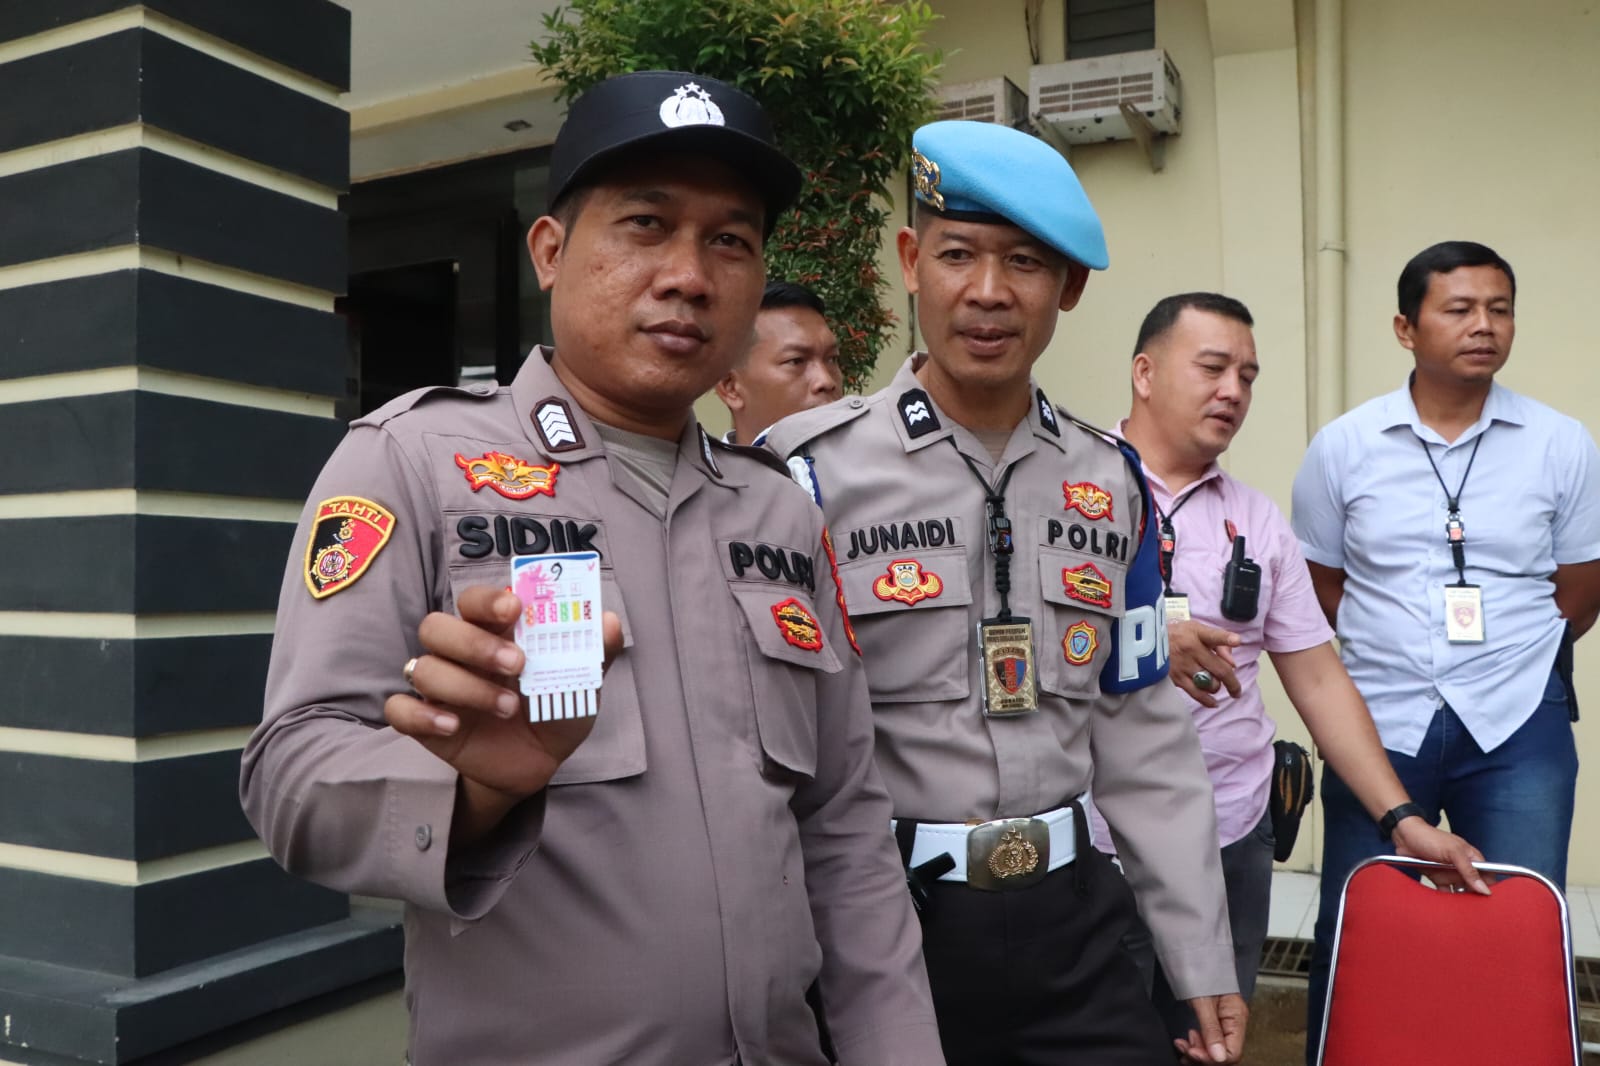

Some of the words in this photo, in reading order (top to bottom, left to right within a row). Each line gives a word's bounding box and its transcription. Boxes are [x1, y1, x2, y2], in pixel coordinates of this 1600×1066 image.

[328, 501, 383, 523] TAHTI
[457, 514, 603, 559] SIDIK
[847, 517, 956, 559] JUNAIDI
[1047, 518, 1129, 562] POLRI
